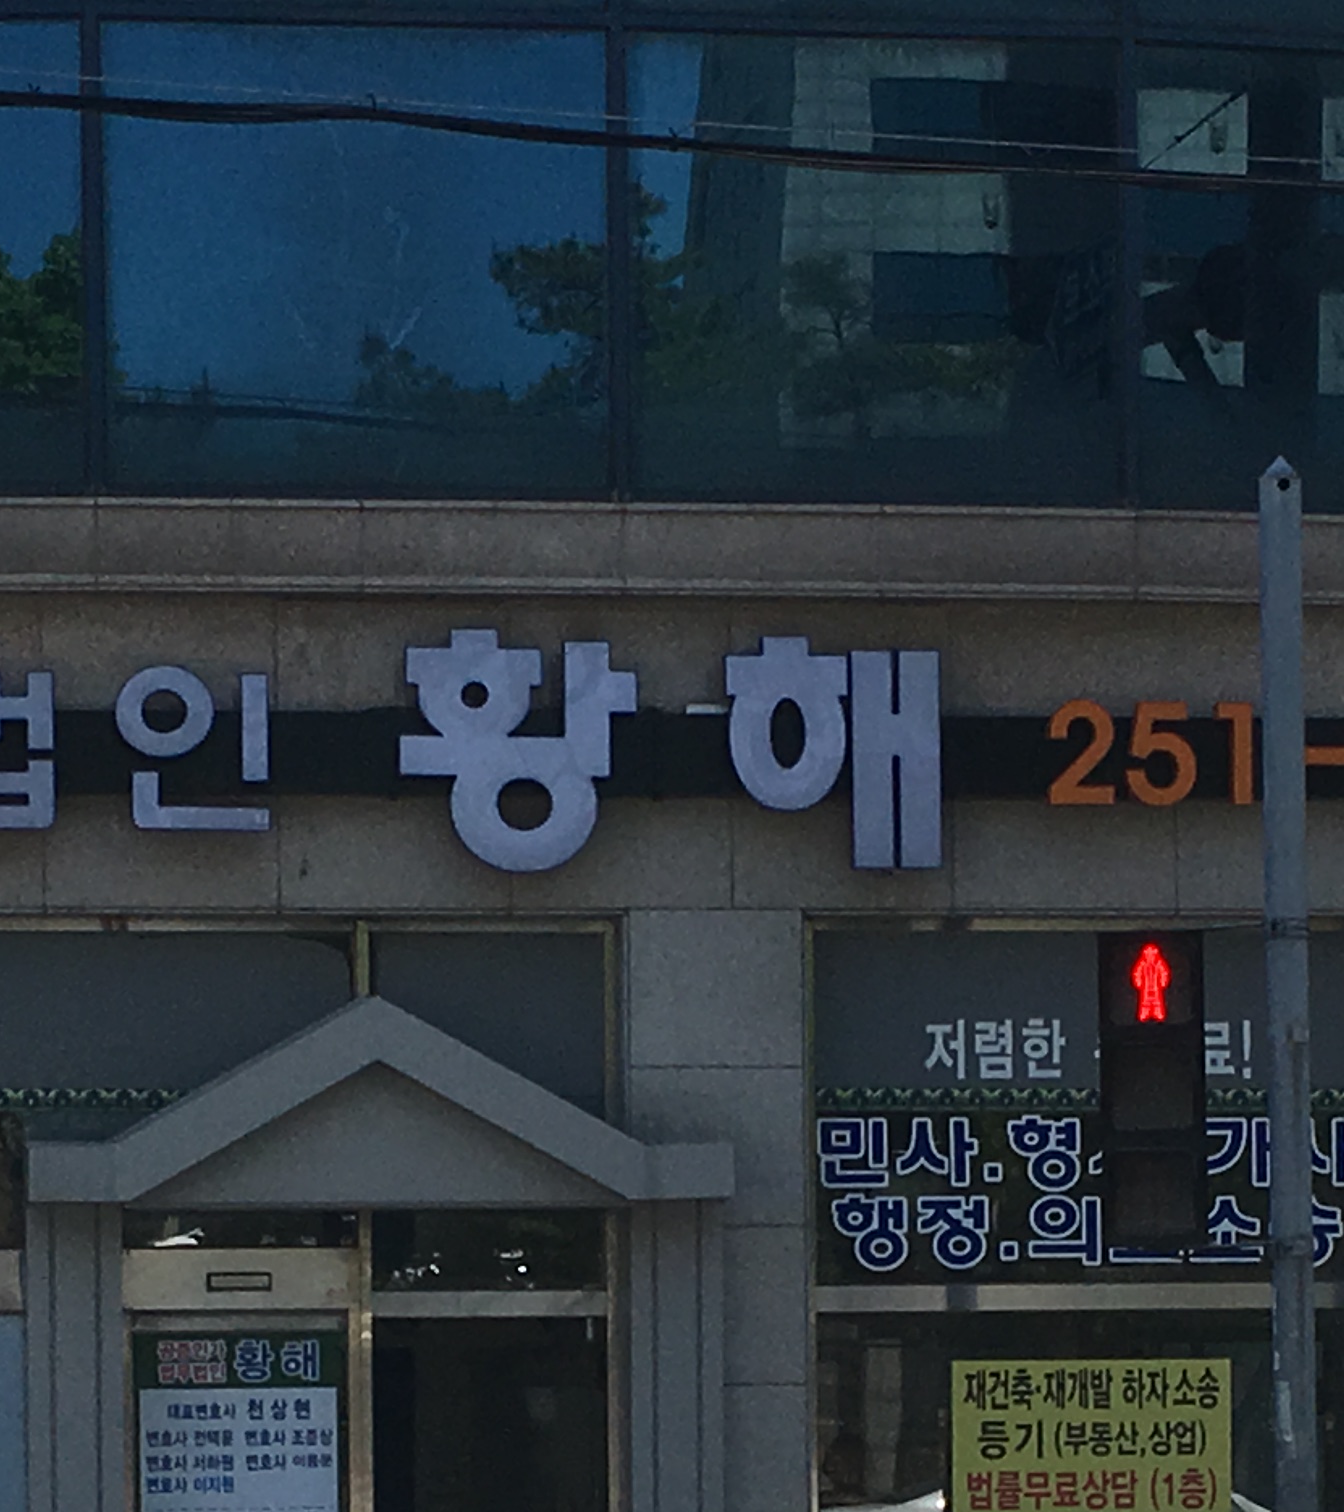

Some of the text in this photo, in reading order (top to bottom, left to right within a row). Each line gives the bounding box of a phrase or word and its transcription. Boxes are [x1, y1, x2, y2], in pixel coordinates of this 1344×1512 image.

[398, 628, 943, 872] 황해
[924, 1017, 1067, 1081] 저렴한
[233, 1338, 320, 1383] 황해
[166, 1402, 236, 1420] 대표변호사
[977, 1419, 1043, 1460] 등기
[966, 1467, 1217, 1511] 법률무료상담 (1층)
